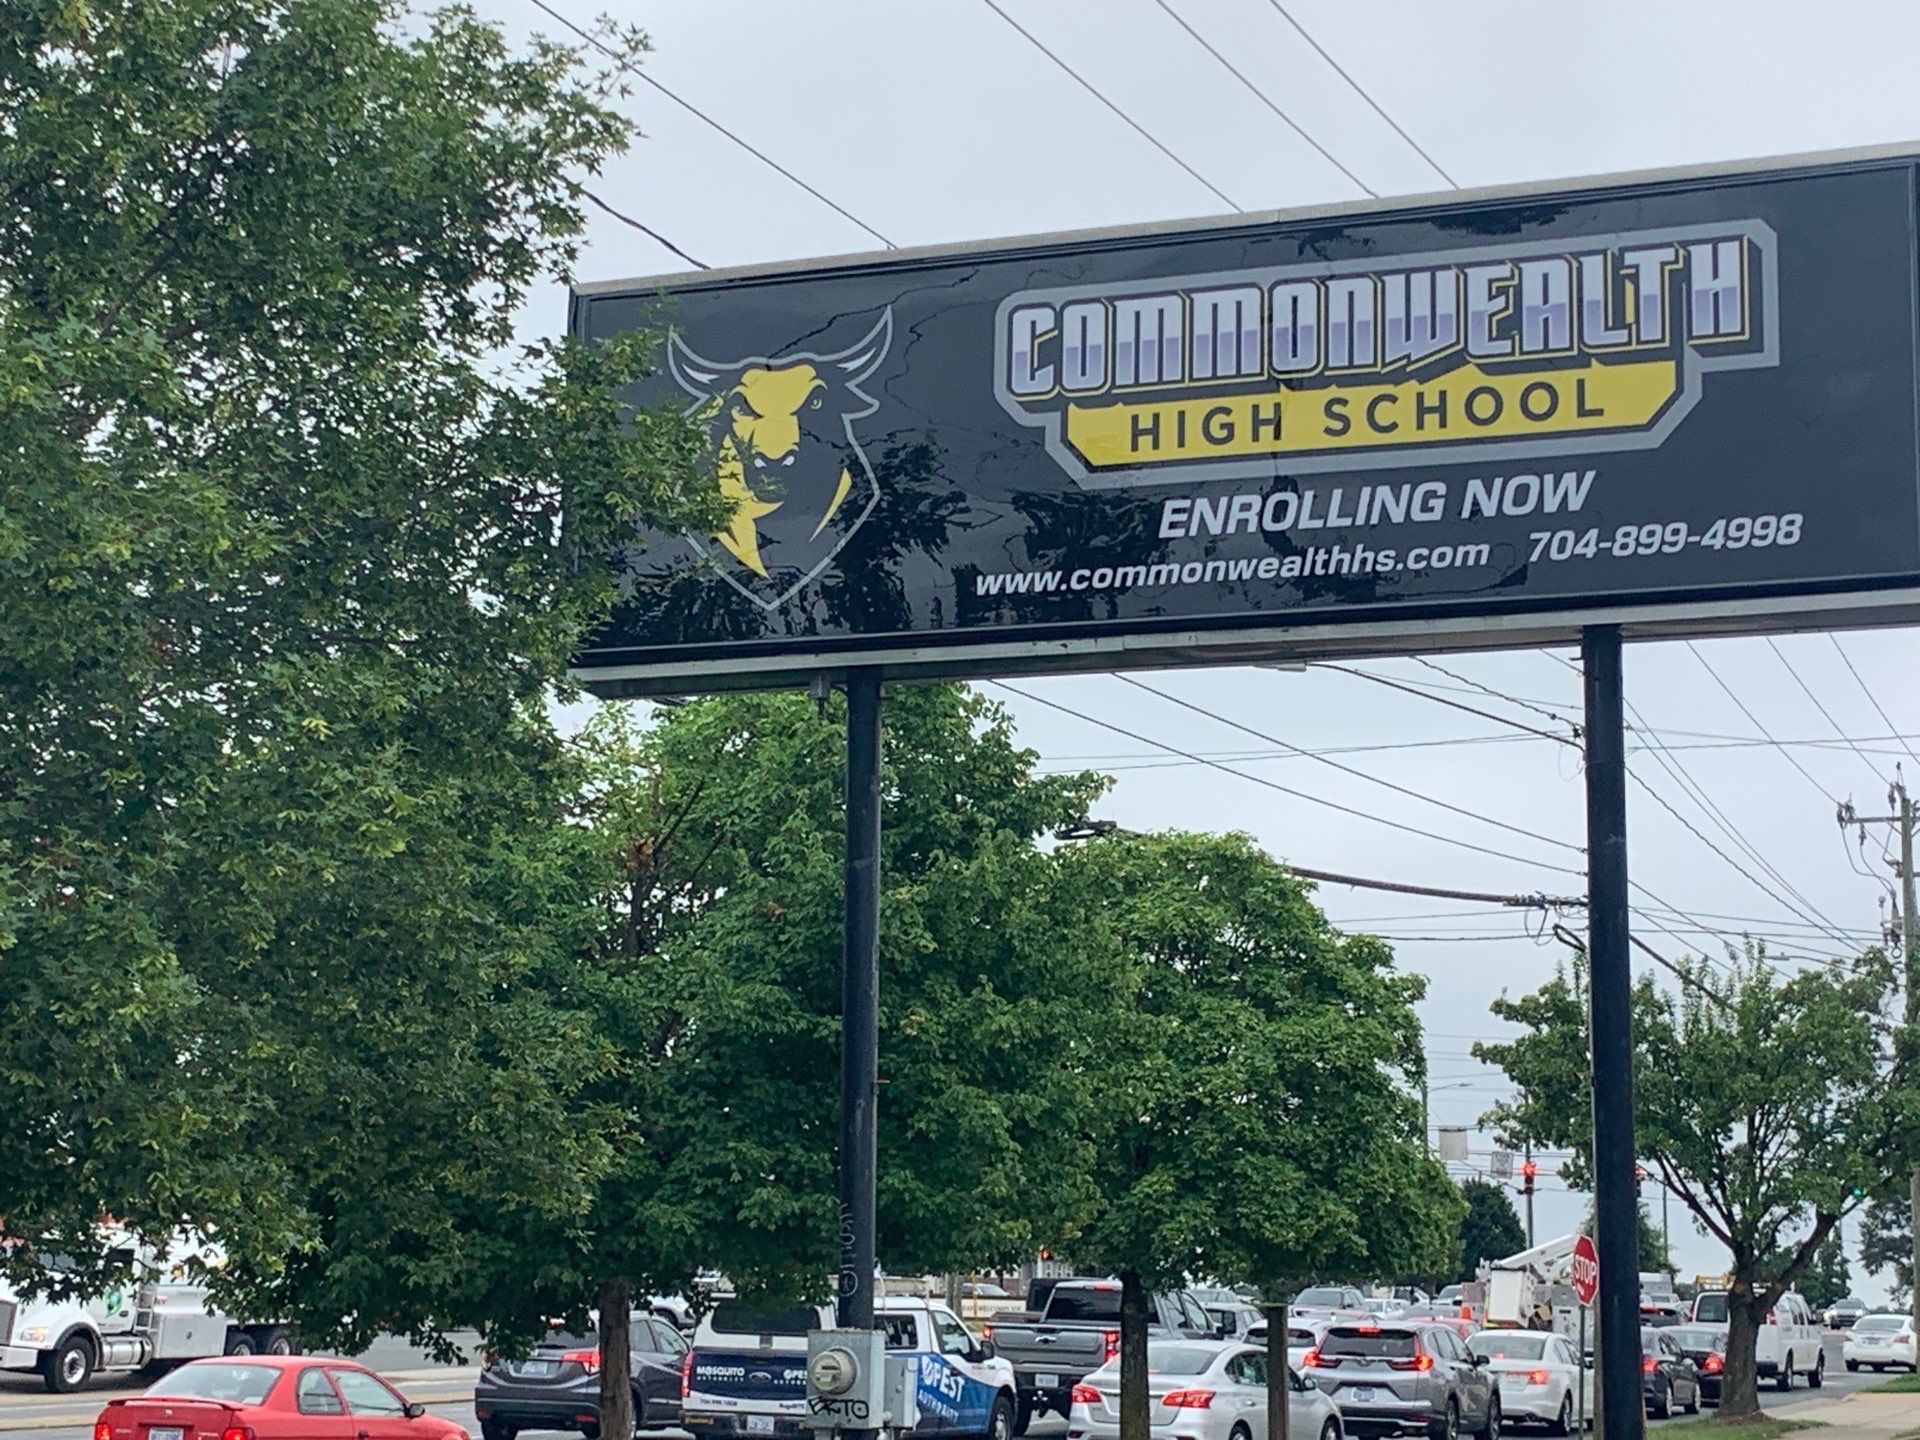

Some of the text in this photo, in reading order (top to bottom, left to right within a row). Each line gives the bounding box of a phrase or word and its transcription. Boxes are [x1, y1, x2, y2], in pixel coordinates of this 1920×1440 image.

[1010, 236, 1748, 397] COMMONWEALTH
[1130, 378, 1604, 453] HIGH SCHOOL
[1158, 470, 1597, 539] ENROLLING NOW
[1528, 513, 1803, 563] 704-899-4998
[976, 542, 1490, 596] www.commonwealthhs.com
[1574, 1253, 1597, 1286] STOP
[696, 1365, 745, 1377] MOSQUITO
